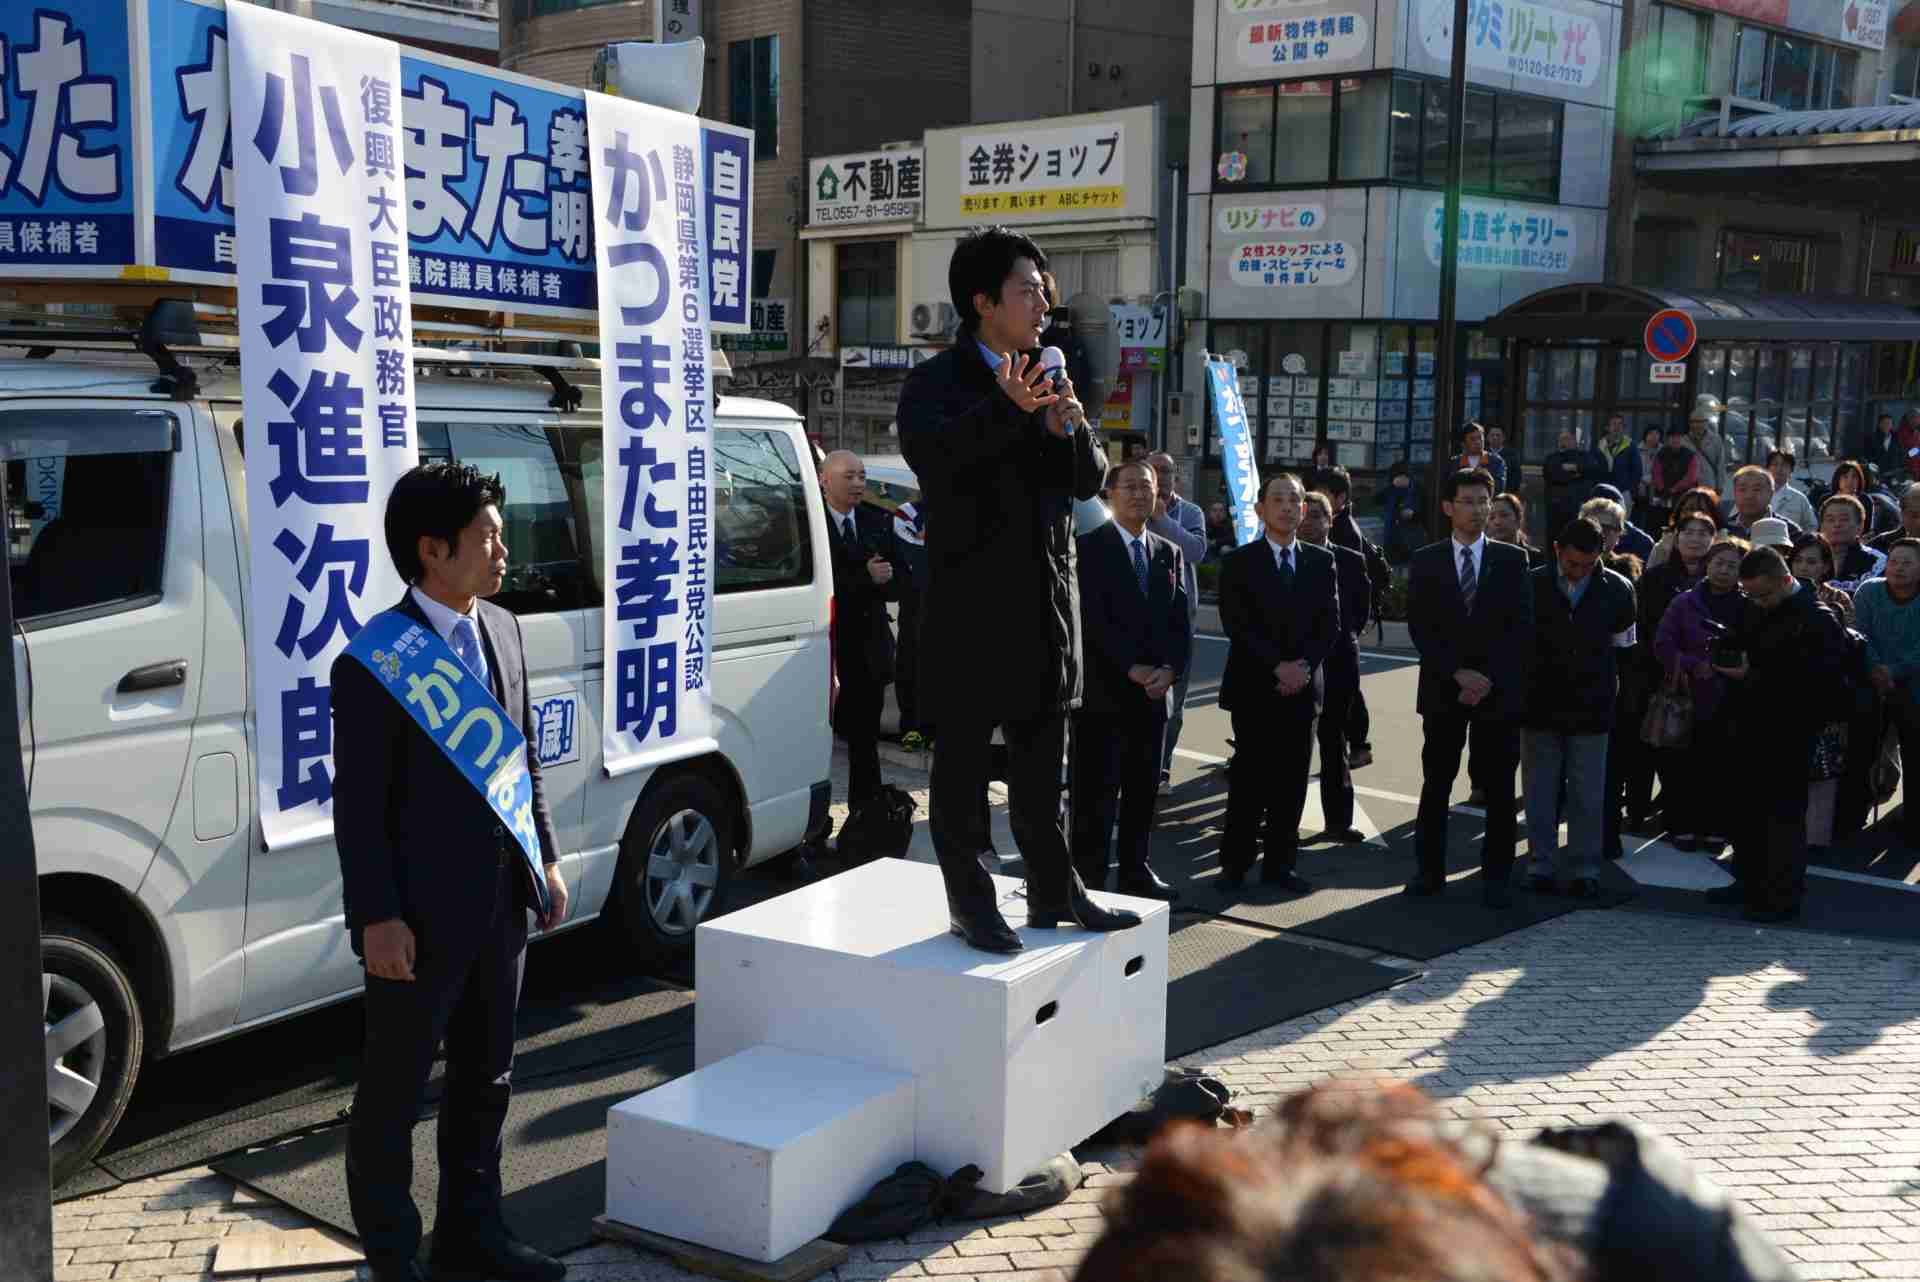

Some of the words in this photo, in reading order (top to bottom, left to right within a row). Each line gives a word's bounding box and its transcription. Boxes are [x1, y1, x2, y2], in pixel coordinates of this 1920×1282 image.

[0, 14, 119, 201] た
[1272, 41, 1329, 63] 公開中
[712, 149, 742, 308] 自民党
[843, 156, 921, 201] 不動産
[968, 131, 1119, 186] 金券ショップ
[1227, 208, 1314, 229] リゾナビの
[360, 74, 408, 449] 復興大臣政務官
[673, 143, 707, 432] 静岡県第6選挙区
[1118, 304, 1168, 339] ョップ
[252, 54, 371, 812] 小泉進次郎
[603, 130, 681, 742] かつまた孝明
[685, 446, 708, 691] 自由民主党公認
[532, 699, 575, 763] 歳!
